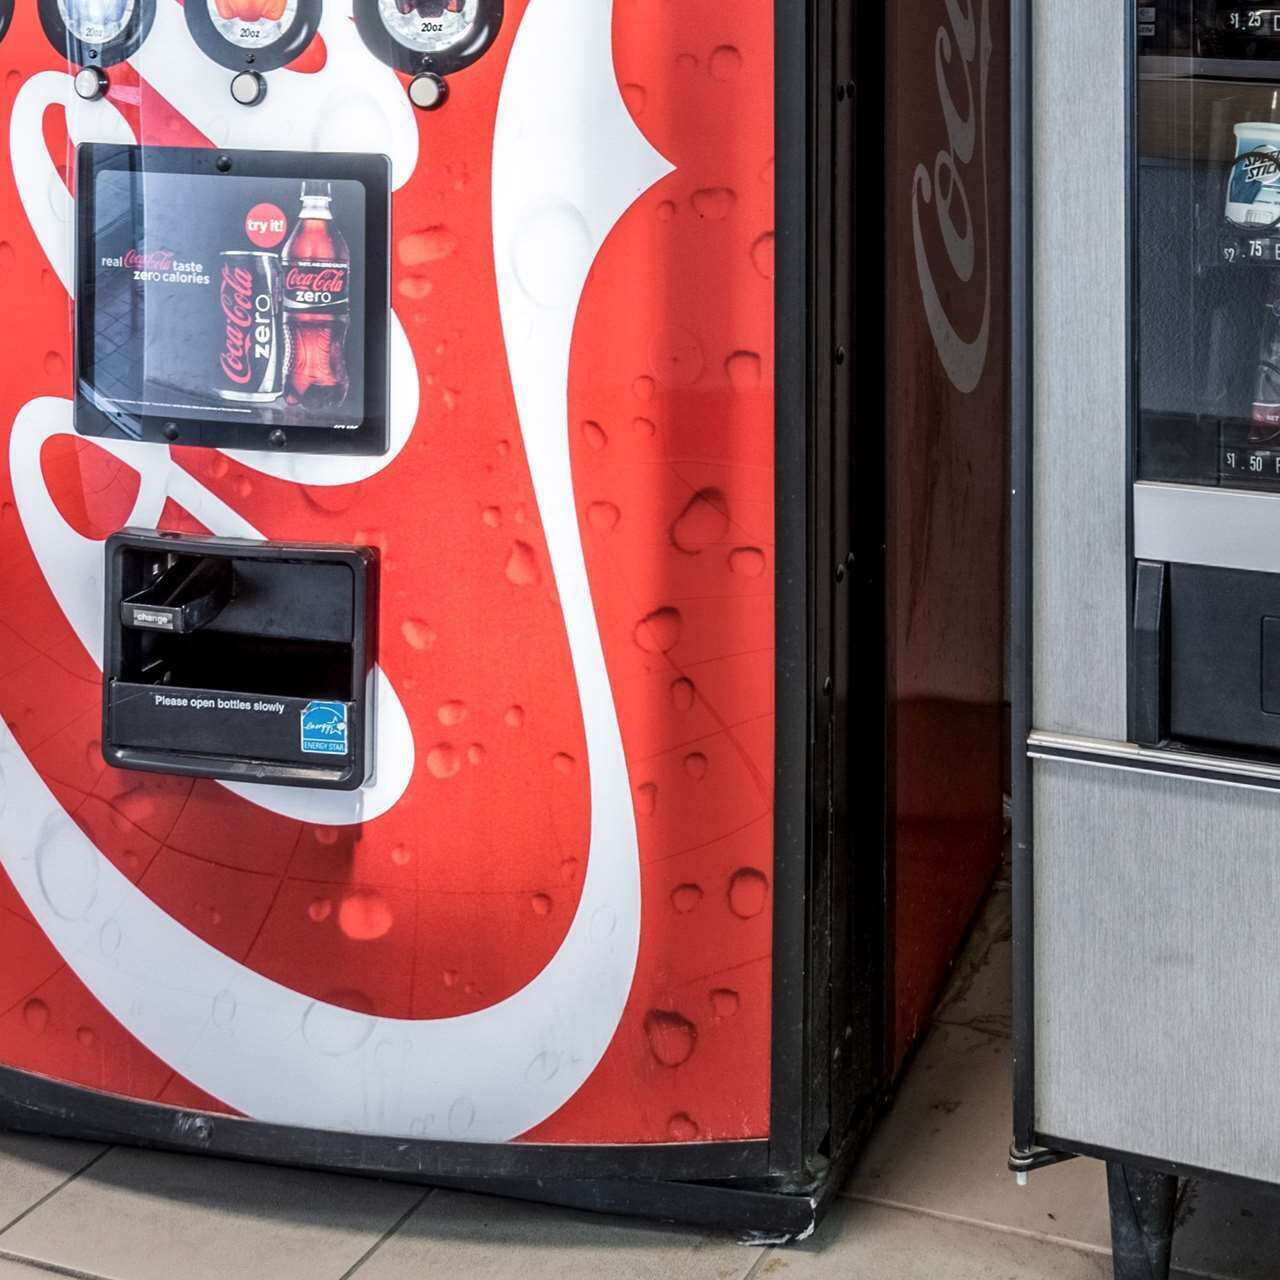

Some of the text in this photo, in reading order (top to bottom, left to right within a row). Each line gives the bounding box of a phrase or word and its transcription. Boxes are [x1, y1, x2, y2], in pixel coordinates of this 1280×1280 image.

[421, 22, 442, 32] 20oz
[248, 219, 284, 232] try it!
[102, 249, 203, 272] real Coca-Cola taste
[134, 272, 209, 284] zero calories
[286, 268, 343, 292] Coca-Cola
[296, 291, 331, 302] zero
[220, 263, 270, 384] Coca-Cola zero
[155, 695, 285, 714] Please open bottles slowly
[304, 741, 327, 751] ENERGY
